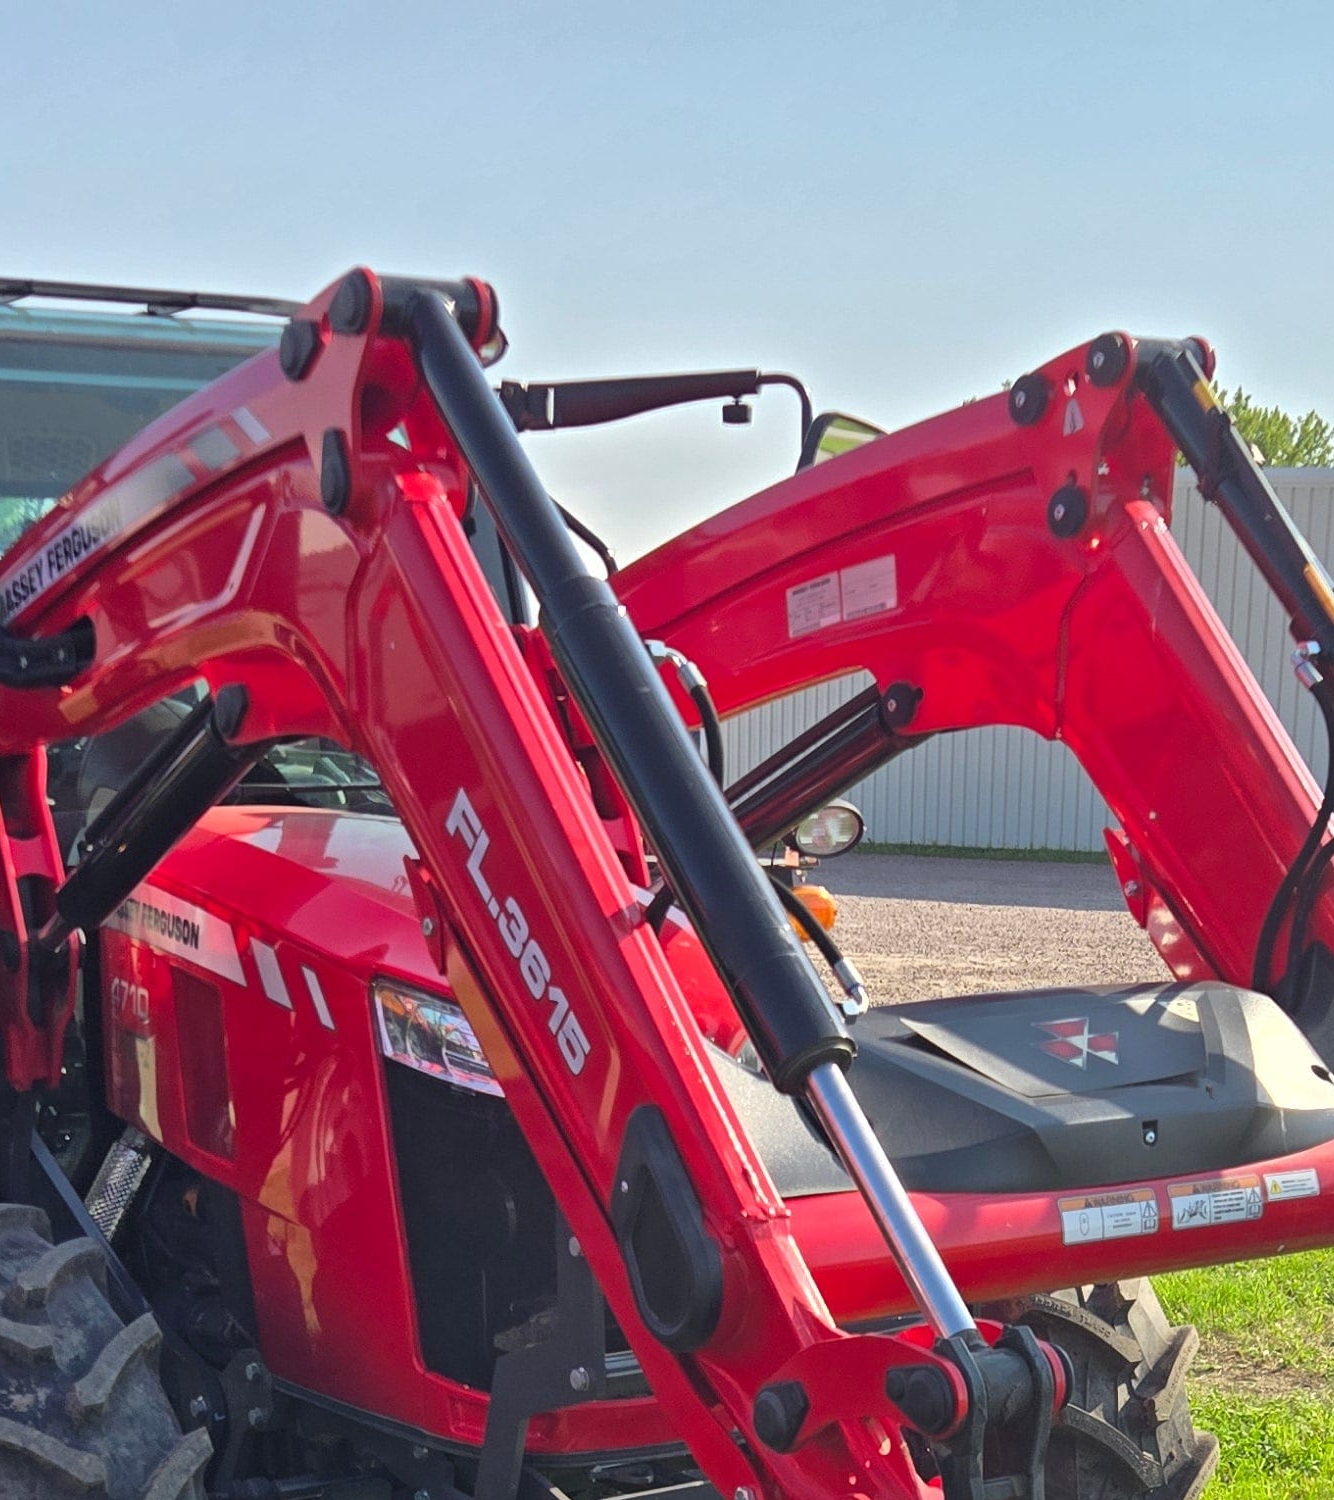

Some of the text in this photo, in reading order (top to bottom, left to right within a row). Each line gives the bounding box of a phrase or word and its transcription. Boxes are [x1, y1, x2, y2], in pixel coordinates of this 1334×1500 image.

[46, 503, 123, 580] FERGUSON
[142, 903, 200, 949] FERGUSON
[445, 787, 591, 1076] FL.3615
